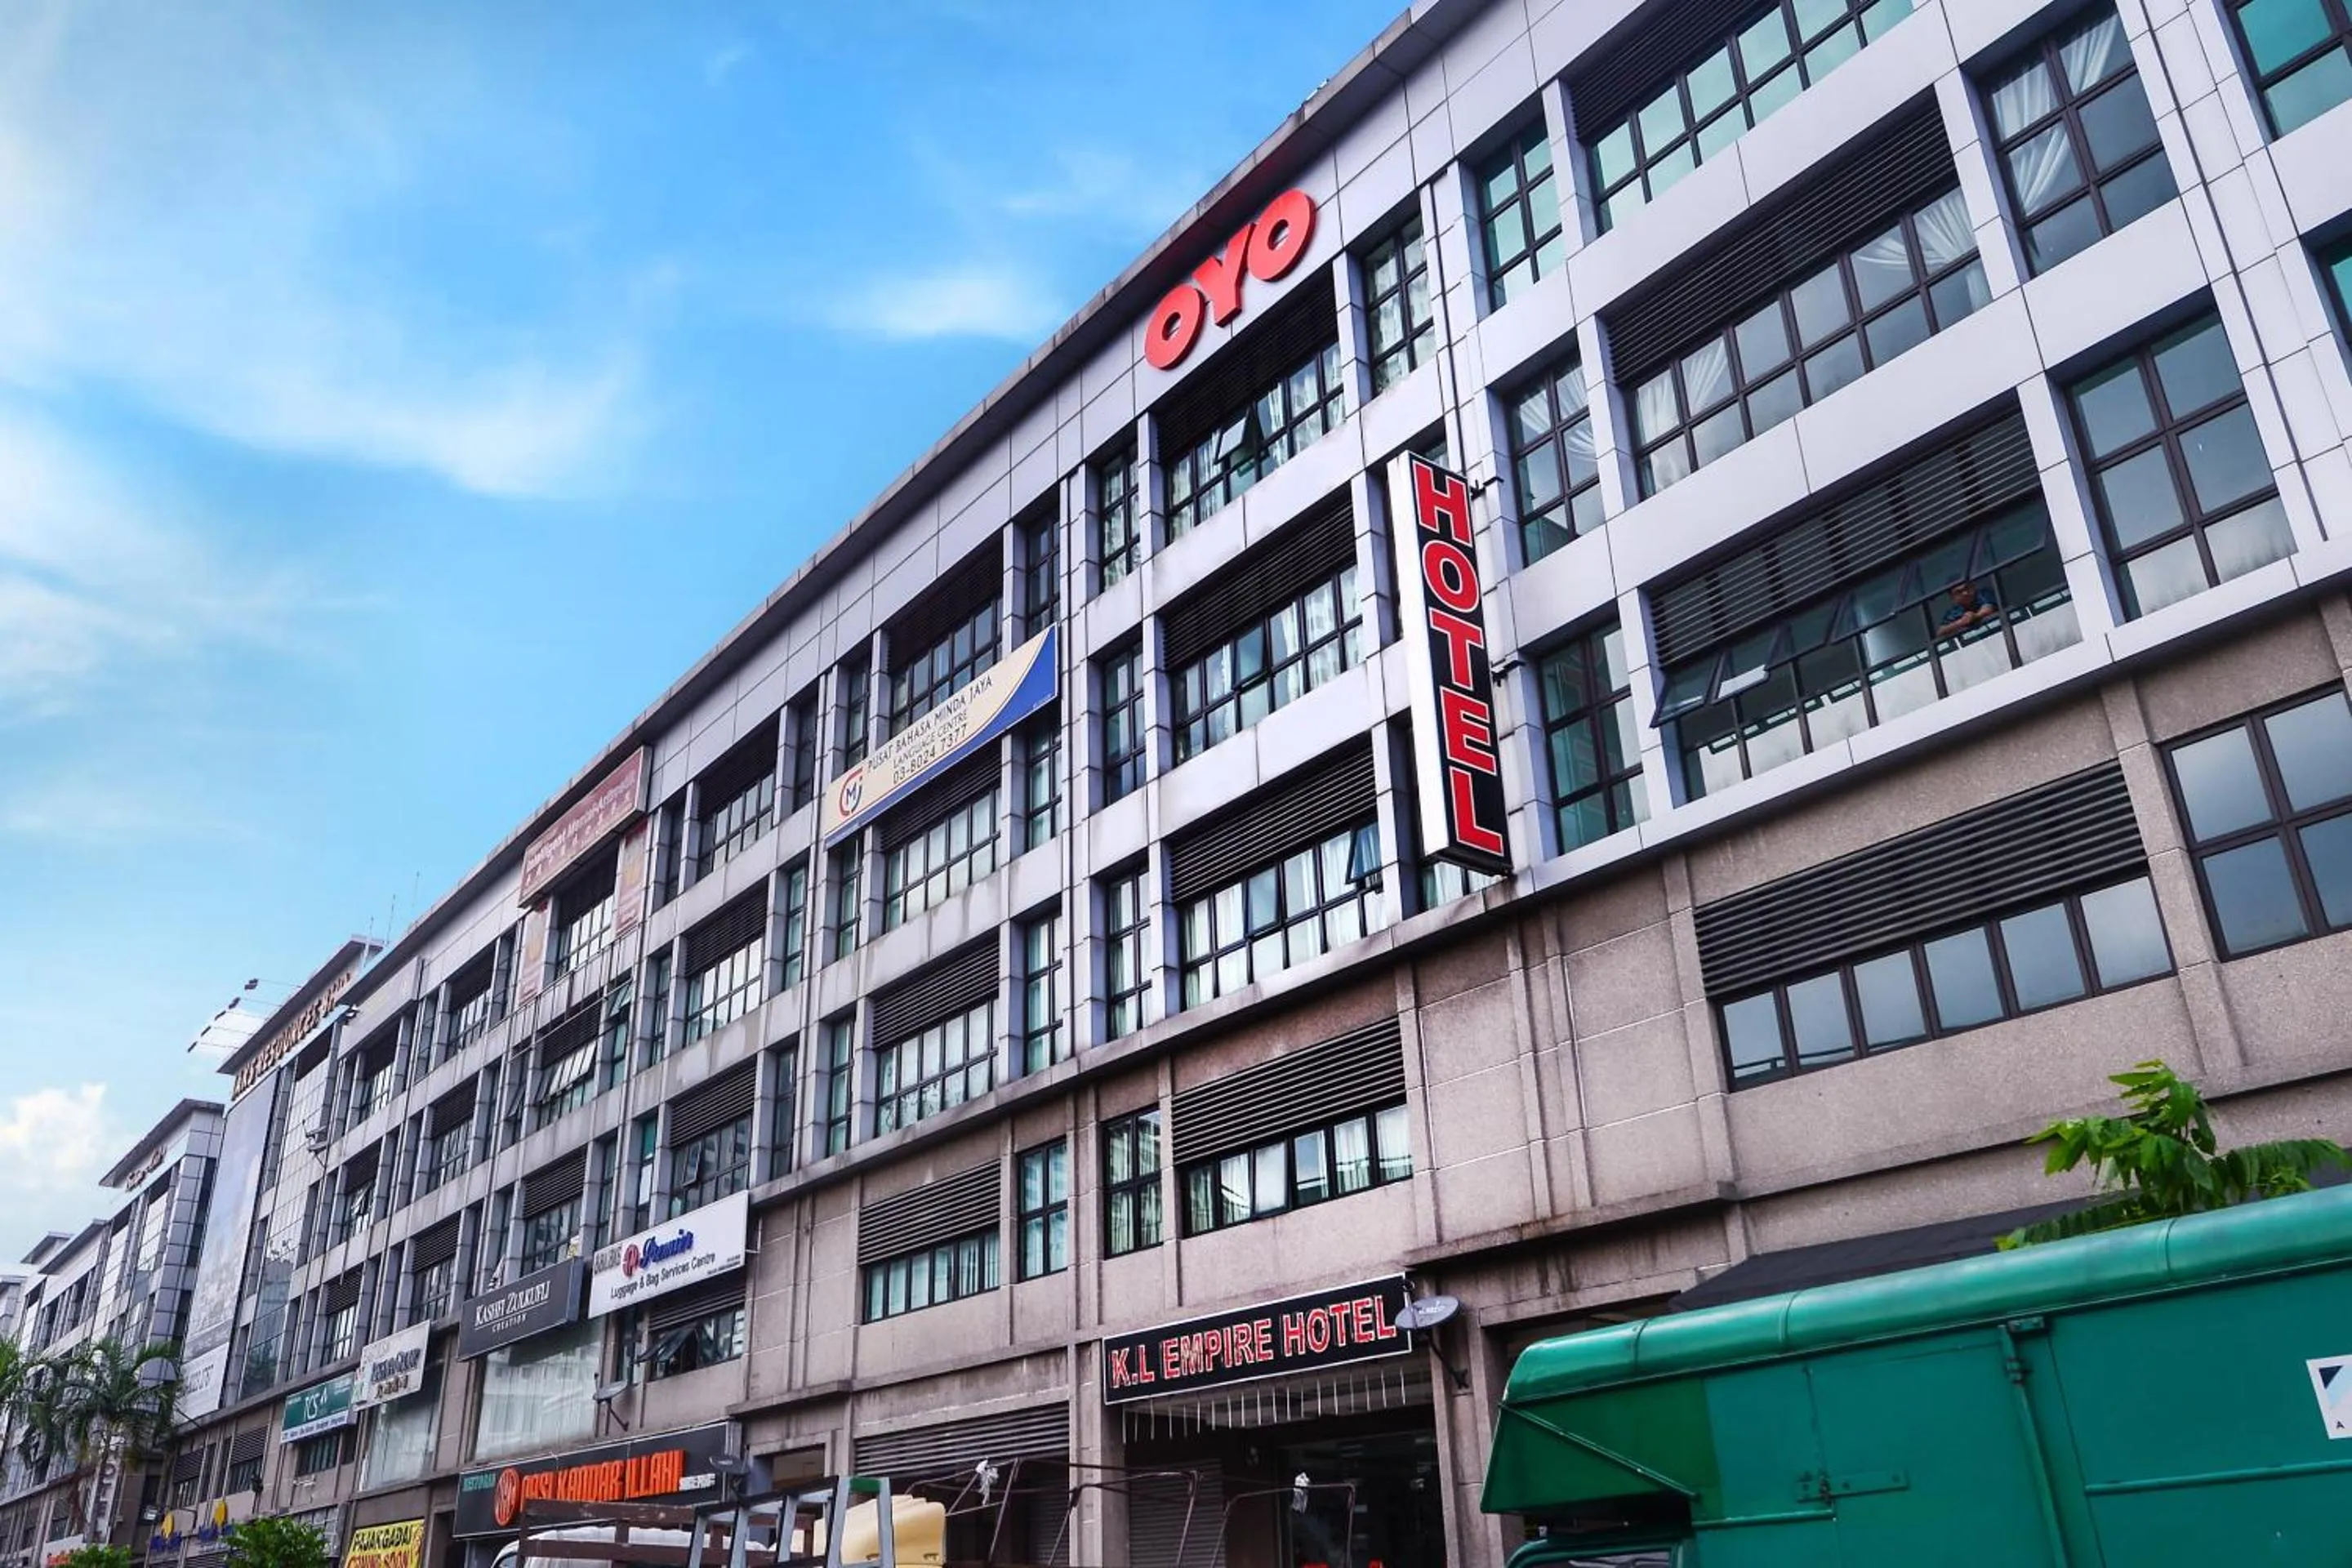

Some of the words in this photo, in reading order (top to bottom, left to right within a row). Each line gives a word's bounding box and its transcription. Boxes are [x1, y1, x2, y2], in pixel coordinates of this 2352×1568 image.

[1144, 187, 1316, 370] OYO
[1411, 458, 1505, 858] HOTEL
[867, 745, 892, 773] PUSAT
[896, 722, 931, 752] BAHASA
[969, 675, 992, 703] JAYA
[940, 723, 967, 751] 7377
[611, 1280, 638, 1299] Luggage
[646, 1272, 659, 1287] Bag
[661, 1264, 690, 1282] Services
[691, 1252, 715, 1269] Centre
[1111, 1344, 1155, 1388] K.L
[1161, 1318, 1274, 1379] EMPIRE
[1282, 1294, 1397, 1356] HOTEL
[626, 1449, 686, 1498] ILLAHI
